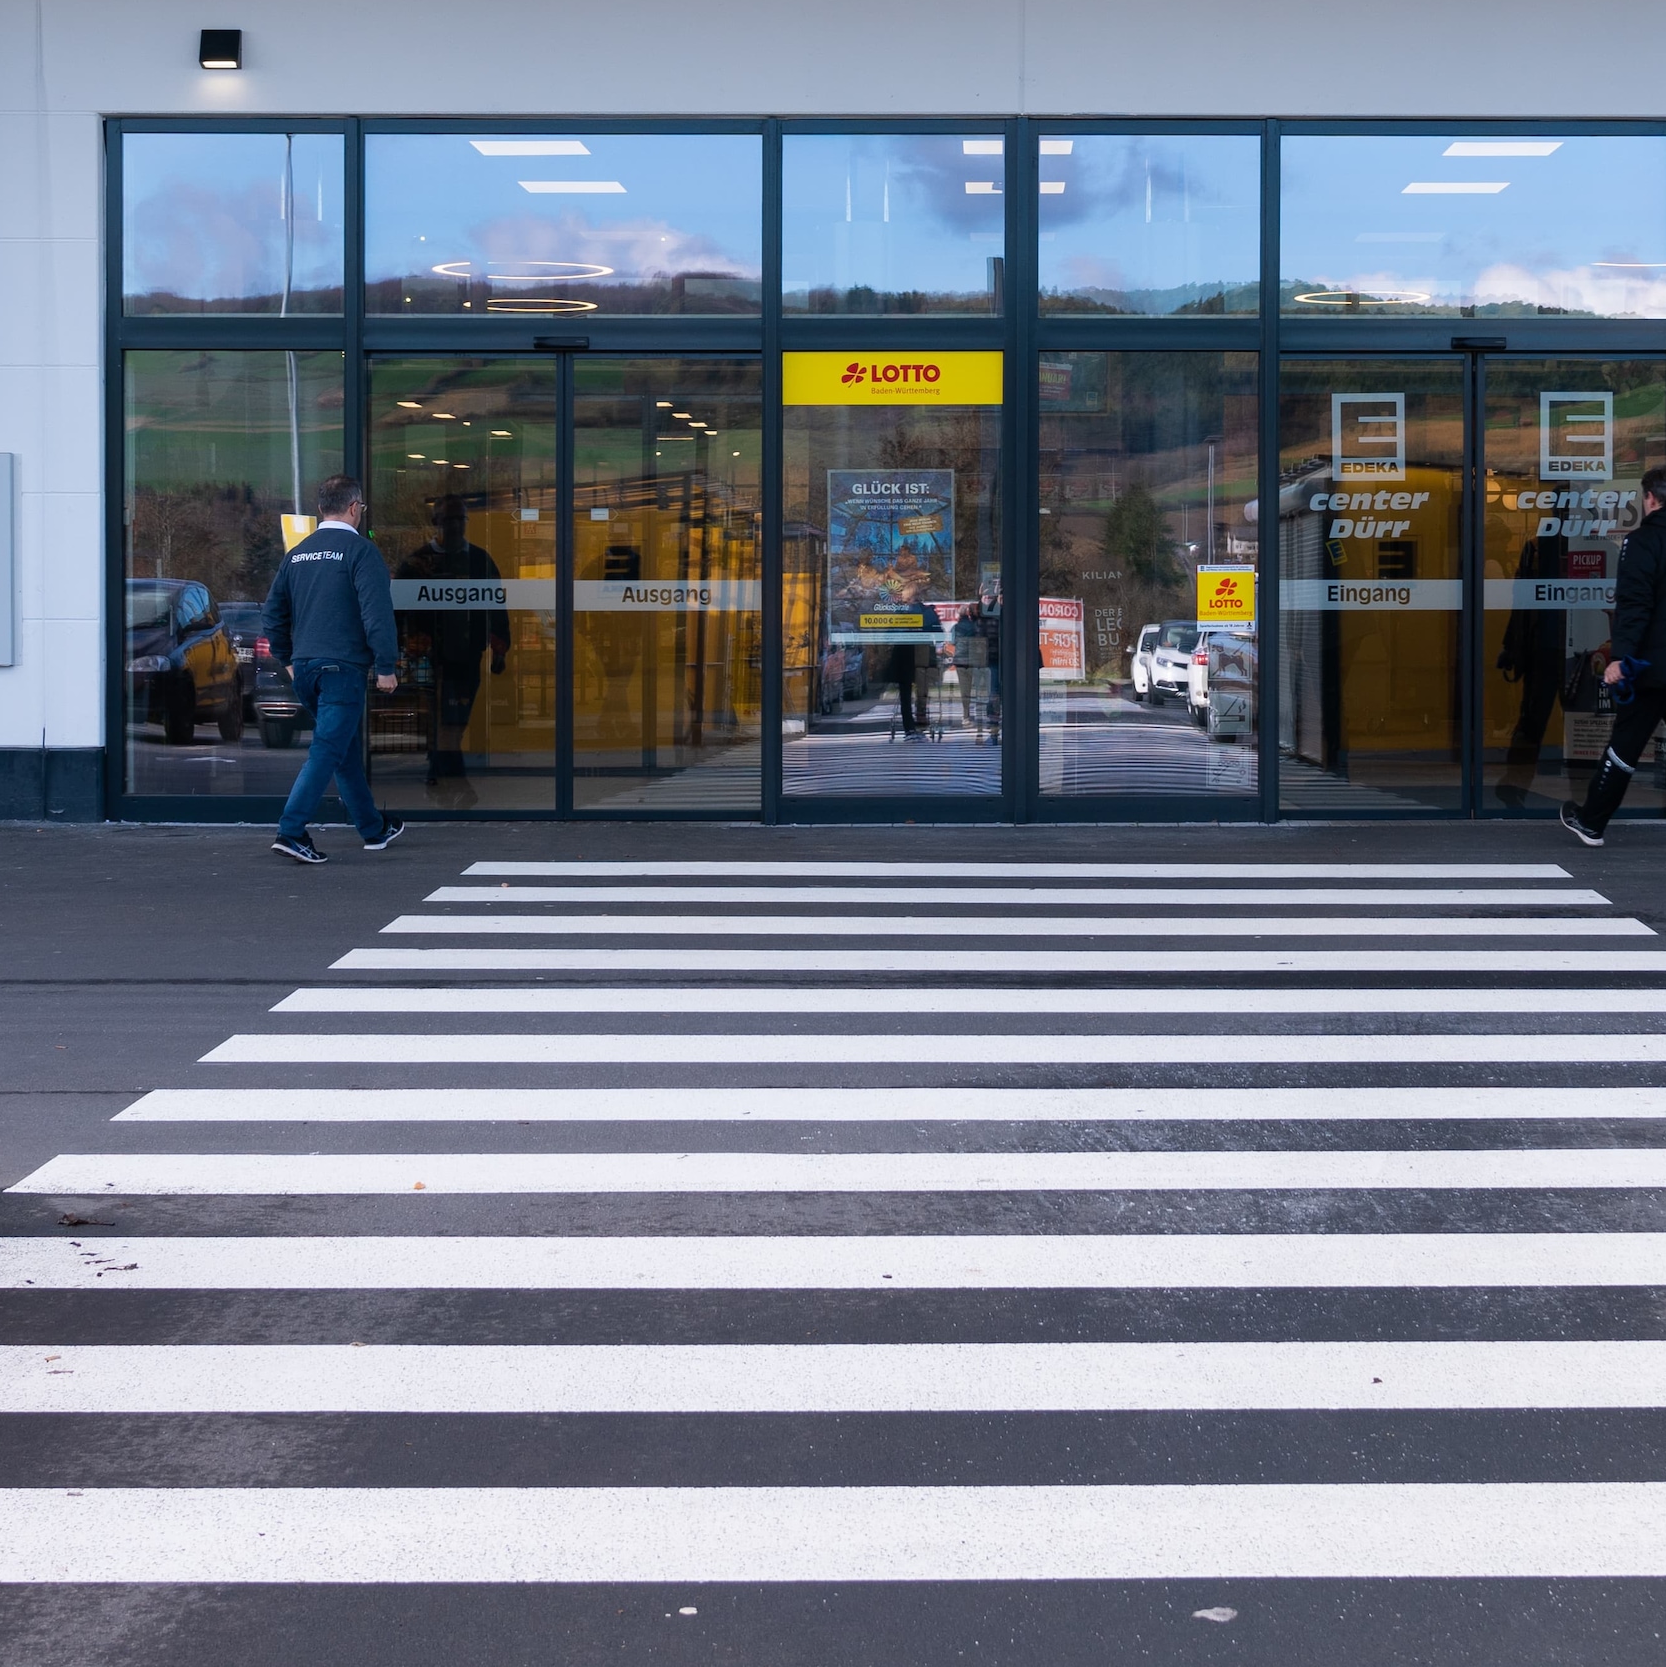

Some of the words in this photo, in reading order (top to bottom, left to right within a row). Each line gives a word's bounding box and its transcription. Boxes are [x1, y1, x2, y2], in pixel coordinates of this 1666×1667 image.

[871, 365, 940, 382] LOTTO
[871, 387, 940, 395] Baden-Württemberg
[1341, 462, 1399, 473] EDEKA
[1549, 460, 1606, 472] EDEKA
[852, 481, 900, 494] GLÜCK
[905, 483, 930, 494] IST:
[1309, 490, 1429, 511] center
[1517, 489, 1637, 509] center
[1329, 516, 1410, 539] Dürr
[1536, 515, 1617, 537] Dürr
[291, 552, 322, 563] SERVICE
[322, 551, 344, 561] TEAM
[1573, 555, 1601, 565] PICKUP
[417, 585, 507, 604] Ausgang
[622, 586, 711, 605] Ausgang
[1328, 585, 1410, 605] Eingang
[1535, 584, 1616, 603] Eingang
[1209, 599, 1243, 608] LOTTO
[1095, 608, 1115, 617] DER
